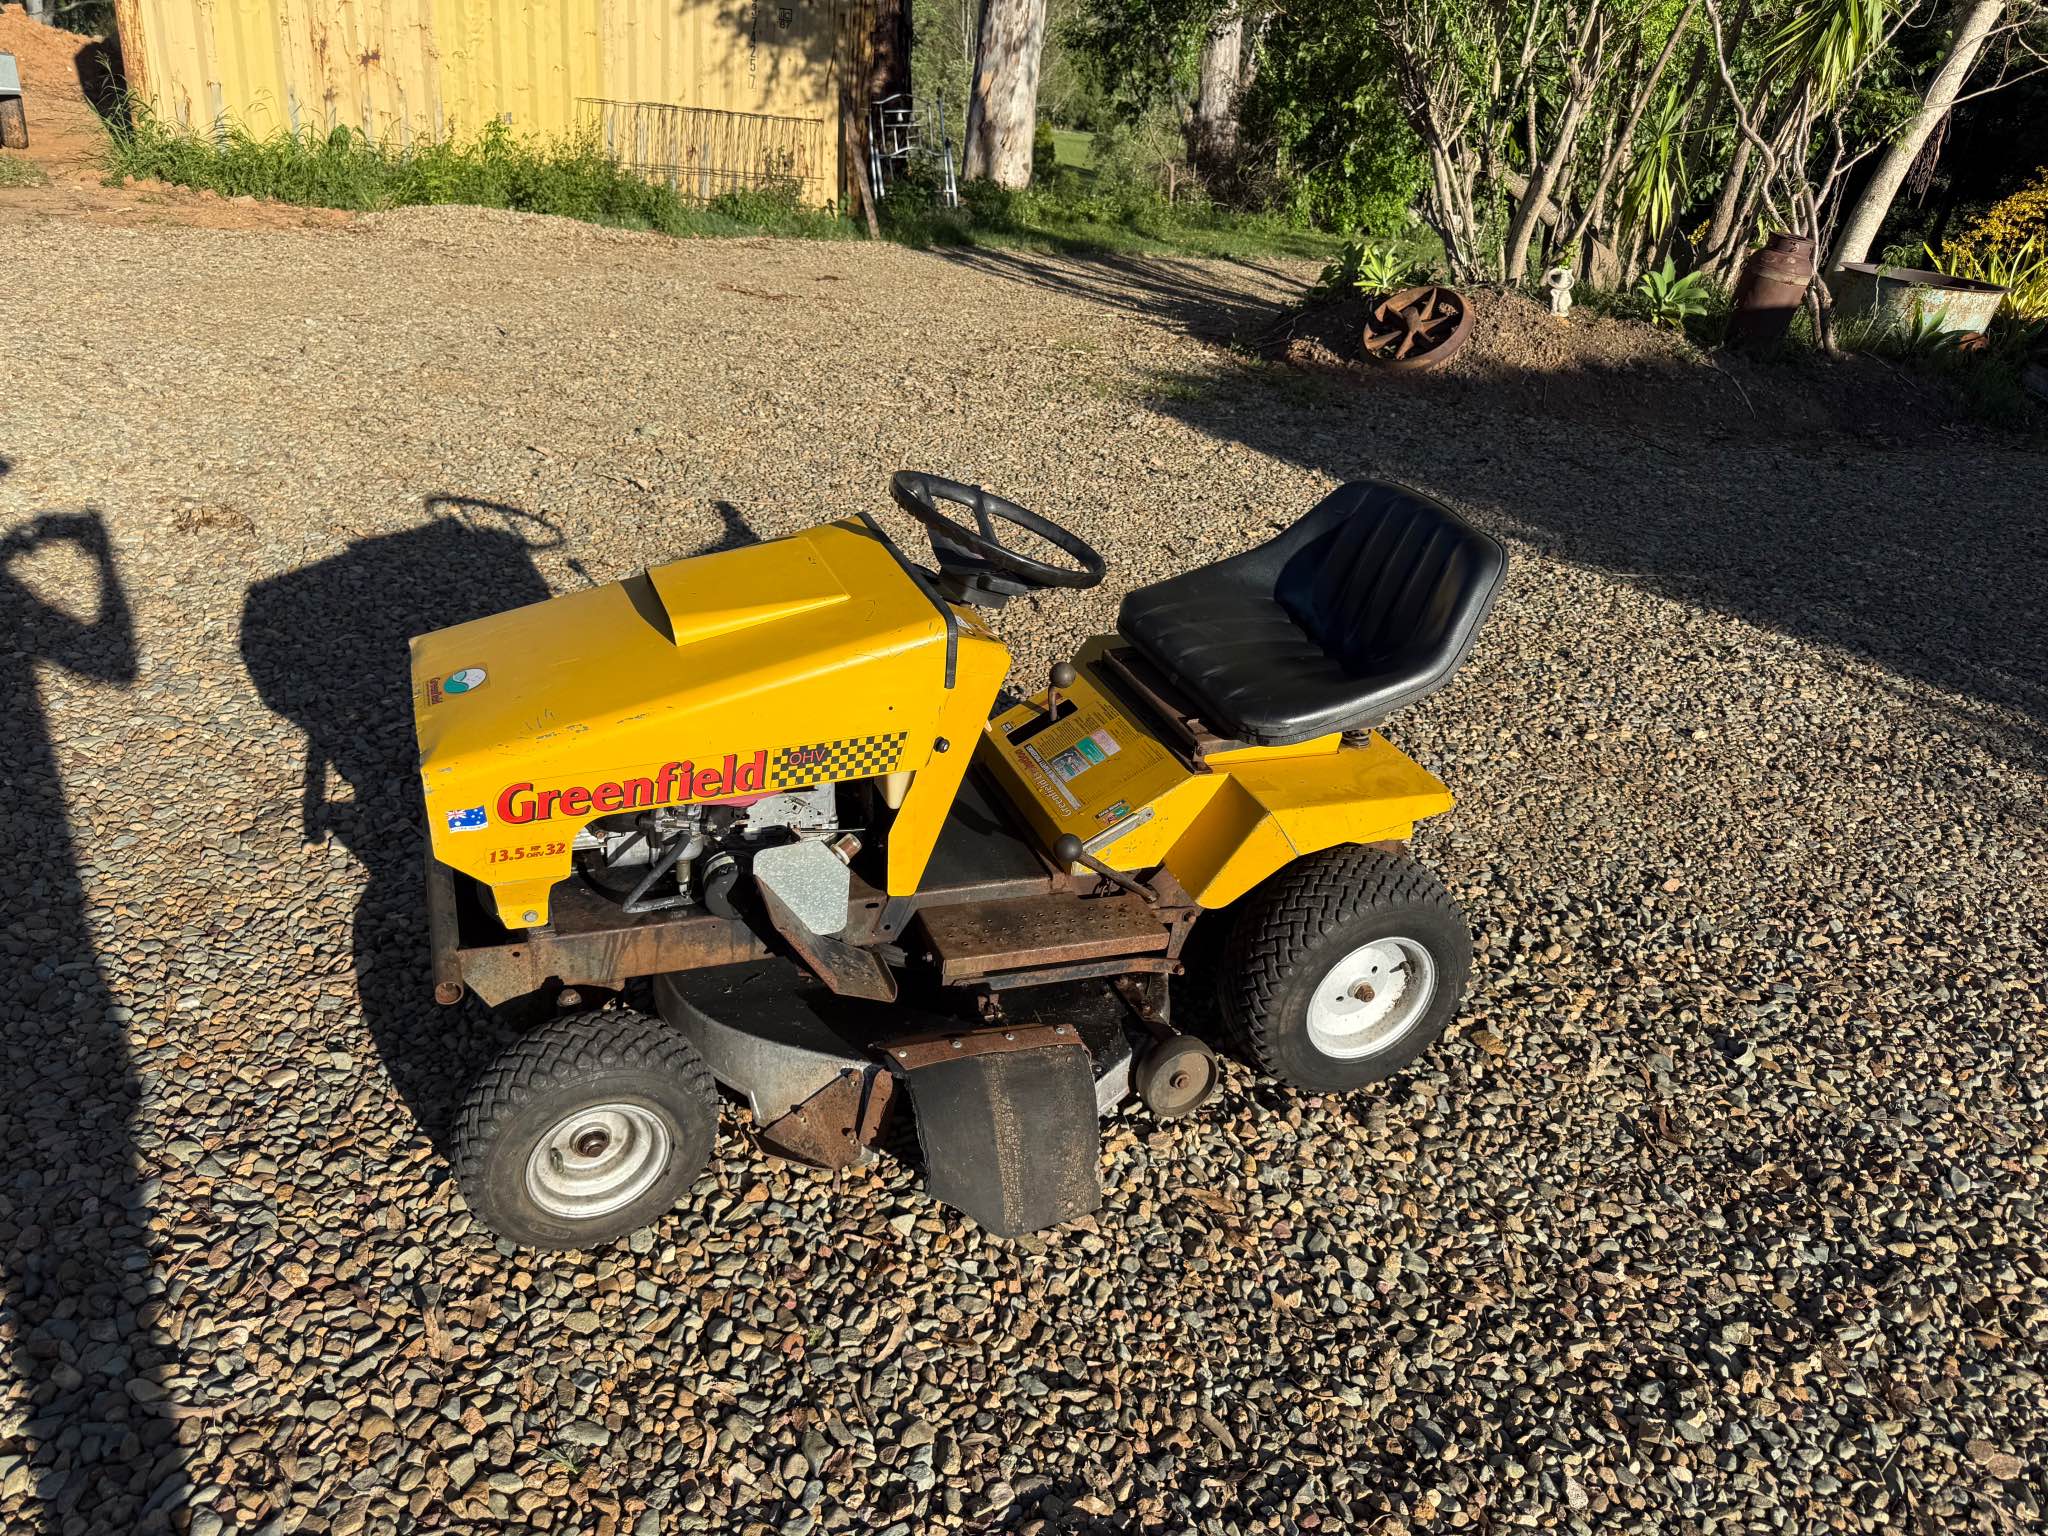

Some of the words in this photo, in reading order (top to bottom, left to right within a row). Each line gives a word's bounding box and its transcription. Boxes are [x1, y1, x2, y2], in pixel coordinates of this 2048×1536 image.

[789, 749, 826, 765] OHV
[497, 750, 769, 824] Greenfield
[1040, 779, 1072, 817] Greenfield
[489, 848, 525, 863] 13.5
[526, 851, 544, 859] OHV
[545, 841, 566, 856] 32
